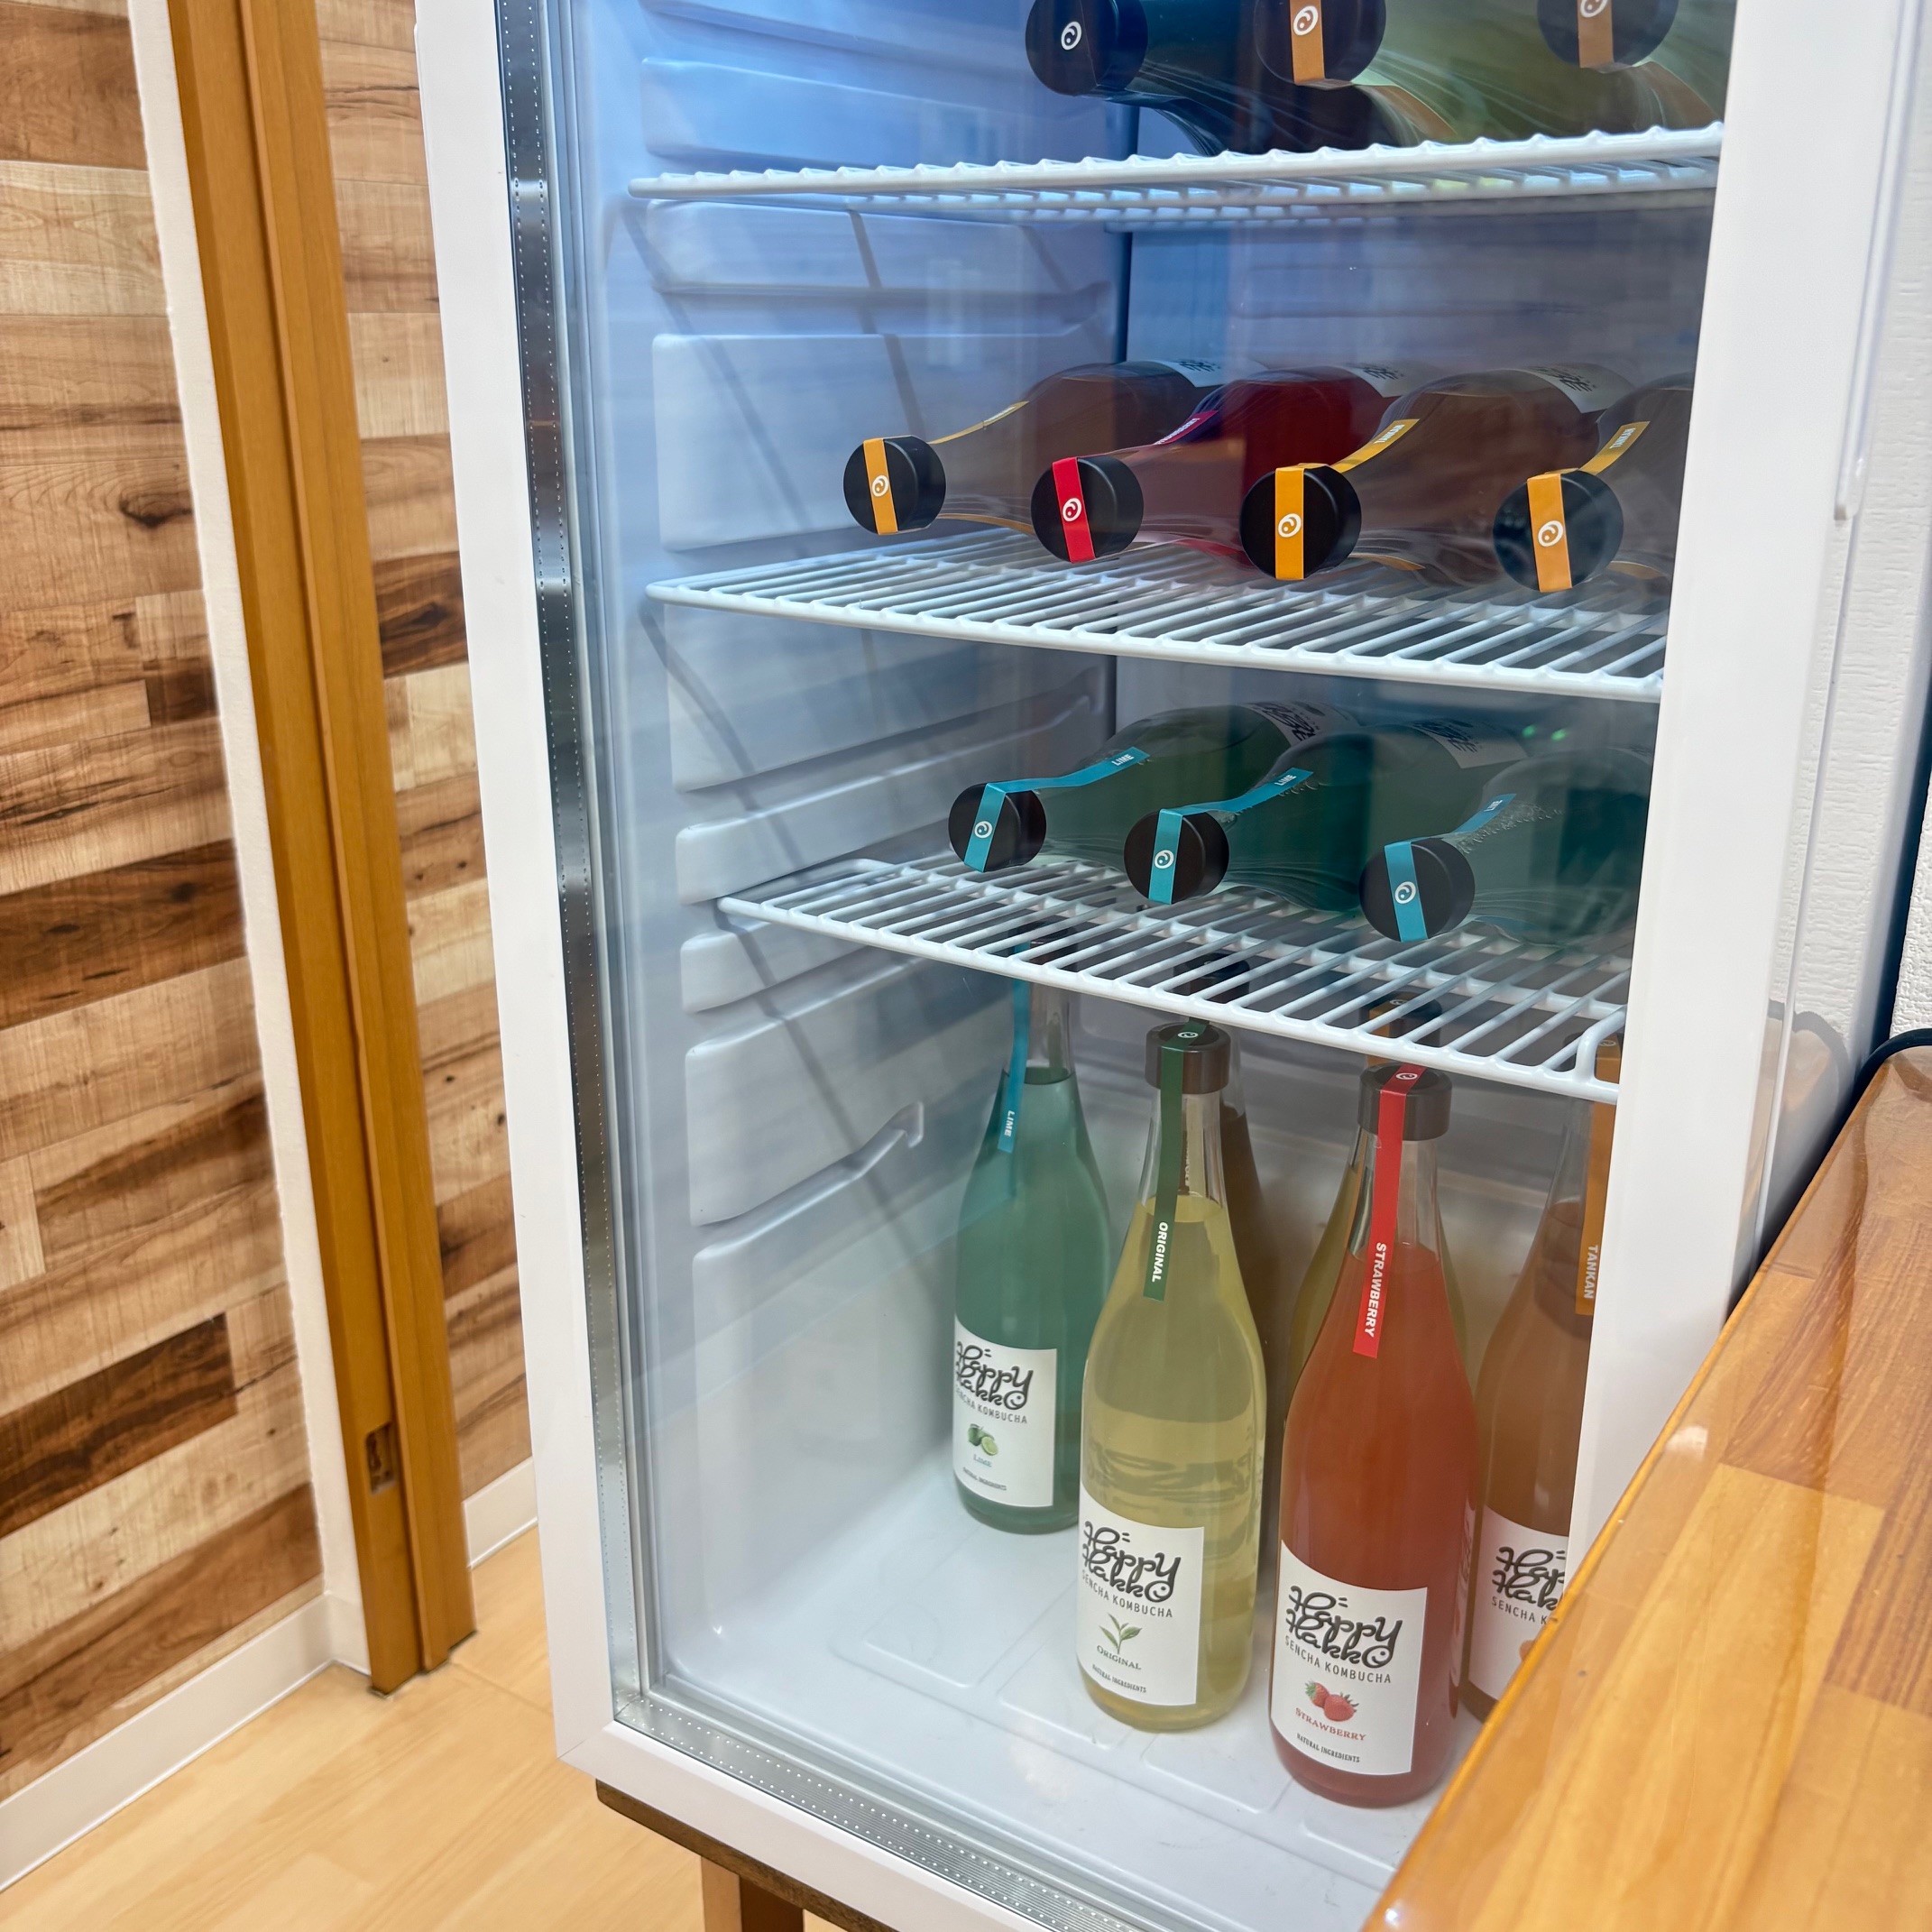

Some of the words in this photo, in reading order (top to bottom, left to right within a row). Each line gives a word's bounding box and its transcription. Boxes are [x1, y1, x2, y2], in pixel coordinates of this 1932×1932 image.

[1111, 754, 1135, 766] LIME
[1274, 775, 1297, 786] LIME
[1004, 1110, 1016, 1137] LIME
[1151, 1221, 1169, 1283] ORIGINAL
[1584, 1245, 1598, 1299] TANKAN
[1365, 1242, 1387, 1338] STRAWBERRY
[977, 1403, 1028, 1424] KOMBUCHA
[1111, 1594, 1173, 1618] KOMBUCHA
[1492, 1596, 1536, 1623] SENCHA
[1284, 1634, 1320, 1669] SENCHA
[1324, 1661, 1392, 1684] KOMBUCHA
[1295, 1707, 1367, 1741] STRAWBERRY
[1296, 1733, 1320, 1751] NATURAL
[1320, 1746, 1361, 1763] INGREDIENTS
